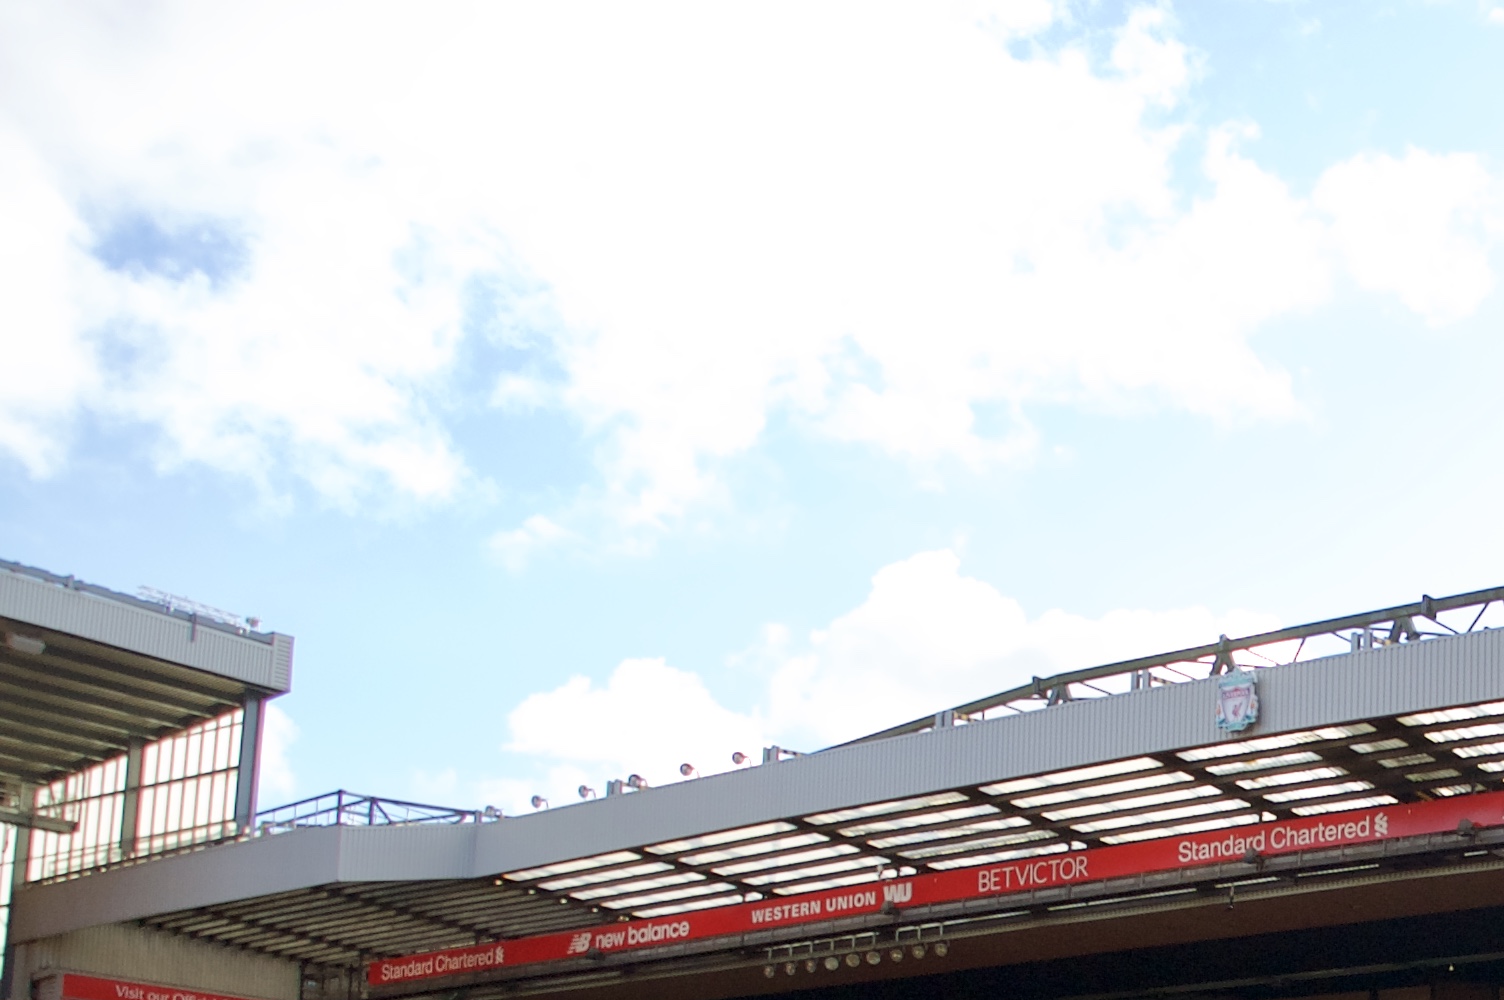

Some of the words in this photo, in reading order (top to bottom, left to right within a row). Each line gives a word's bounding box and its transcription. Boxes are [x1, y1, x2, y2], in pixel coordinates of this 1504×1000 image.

[1178, 831, 1265, 863] Standard
[1270, 816, 1370, 849] Chartered
[978, 856, 1089, 893] BETVICTOR
[752, 900, 822, 924] WESTERN
[826, 891, 876, 913] UNION
[595, 928, 625, 949] new
[628, 921, 689, 945] balance
[381, 955, 433, 981] Standard
[436, 947, 494, 973] Chartered
[115, 984, 144, 1000] Visit
